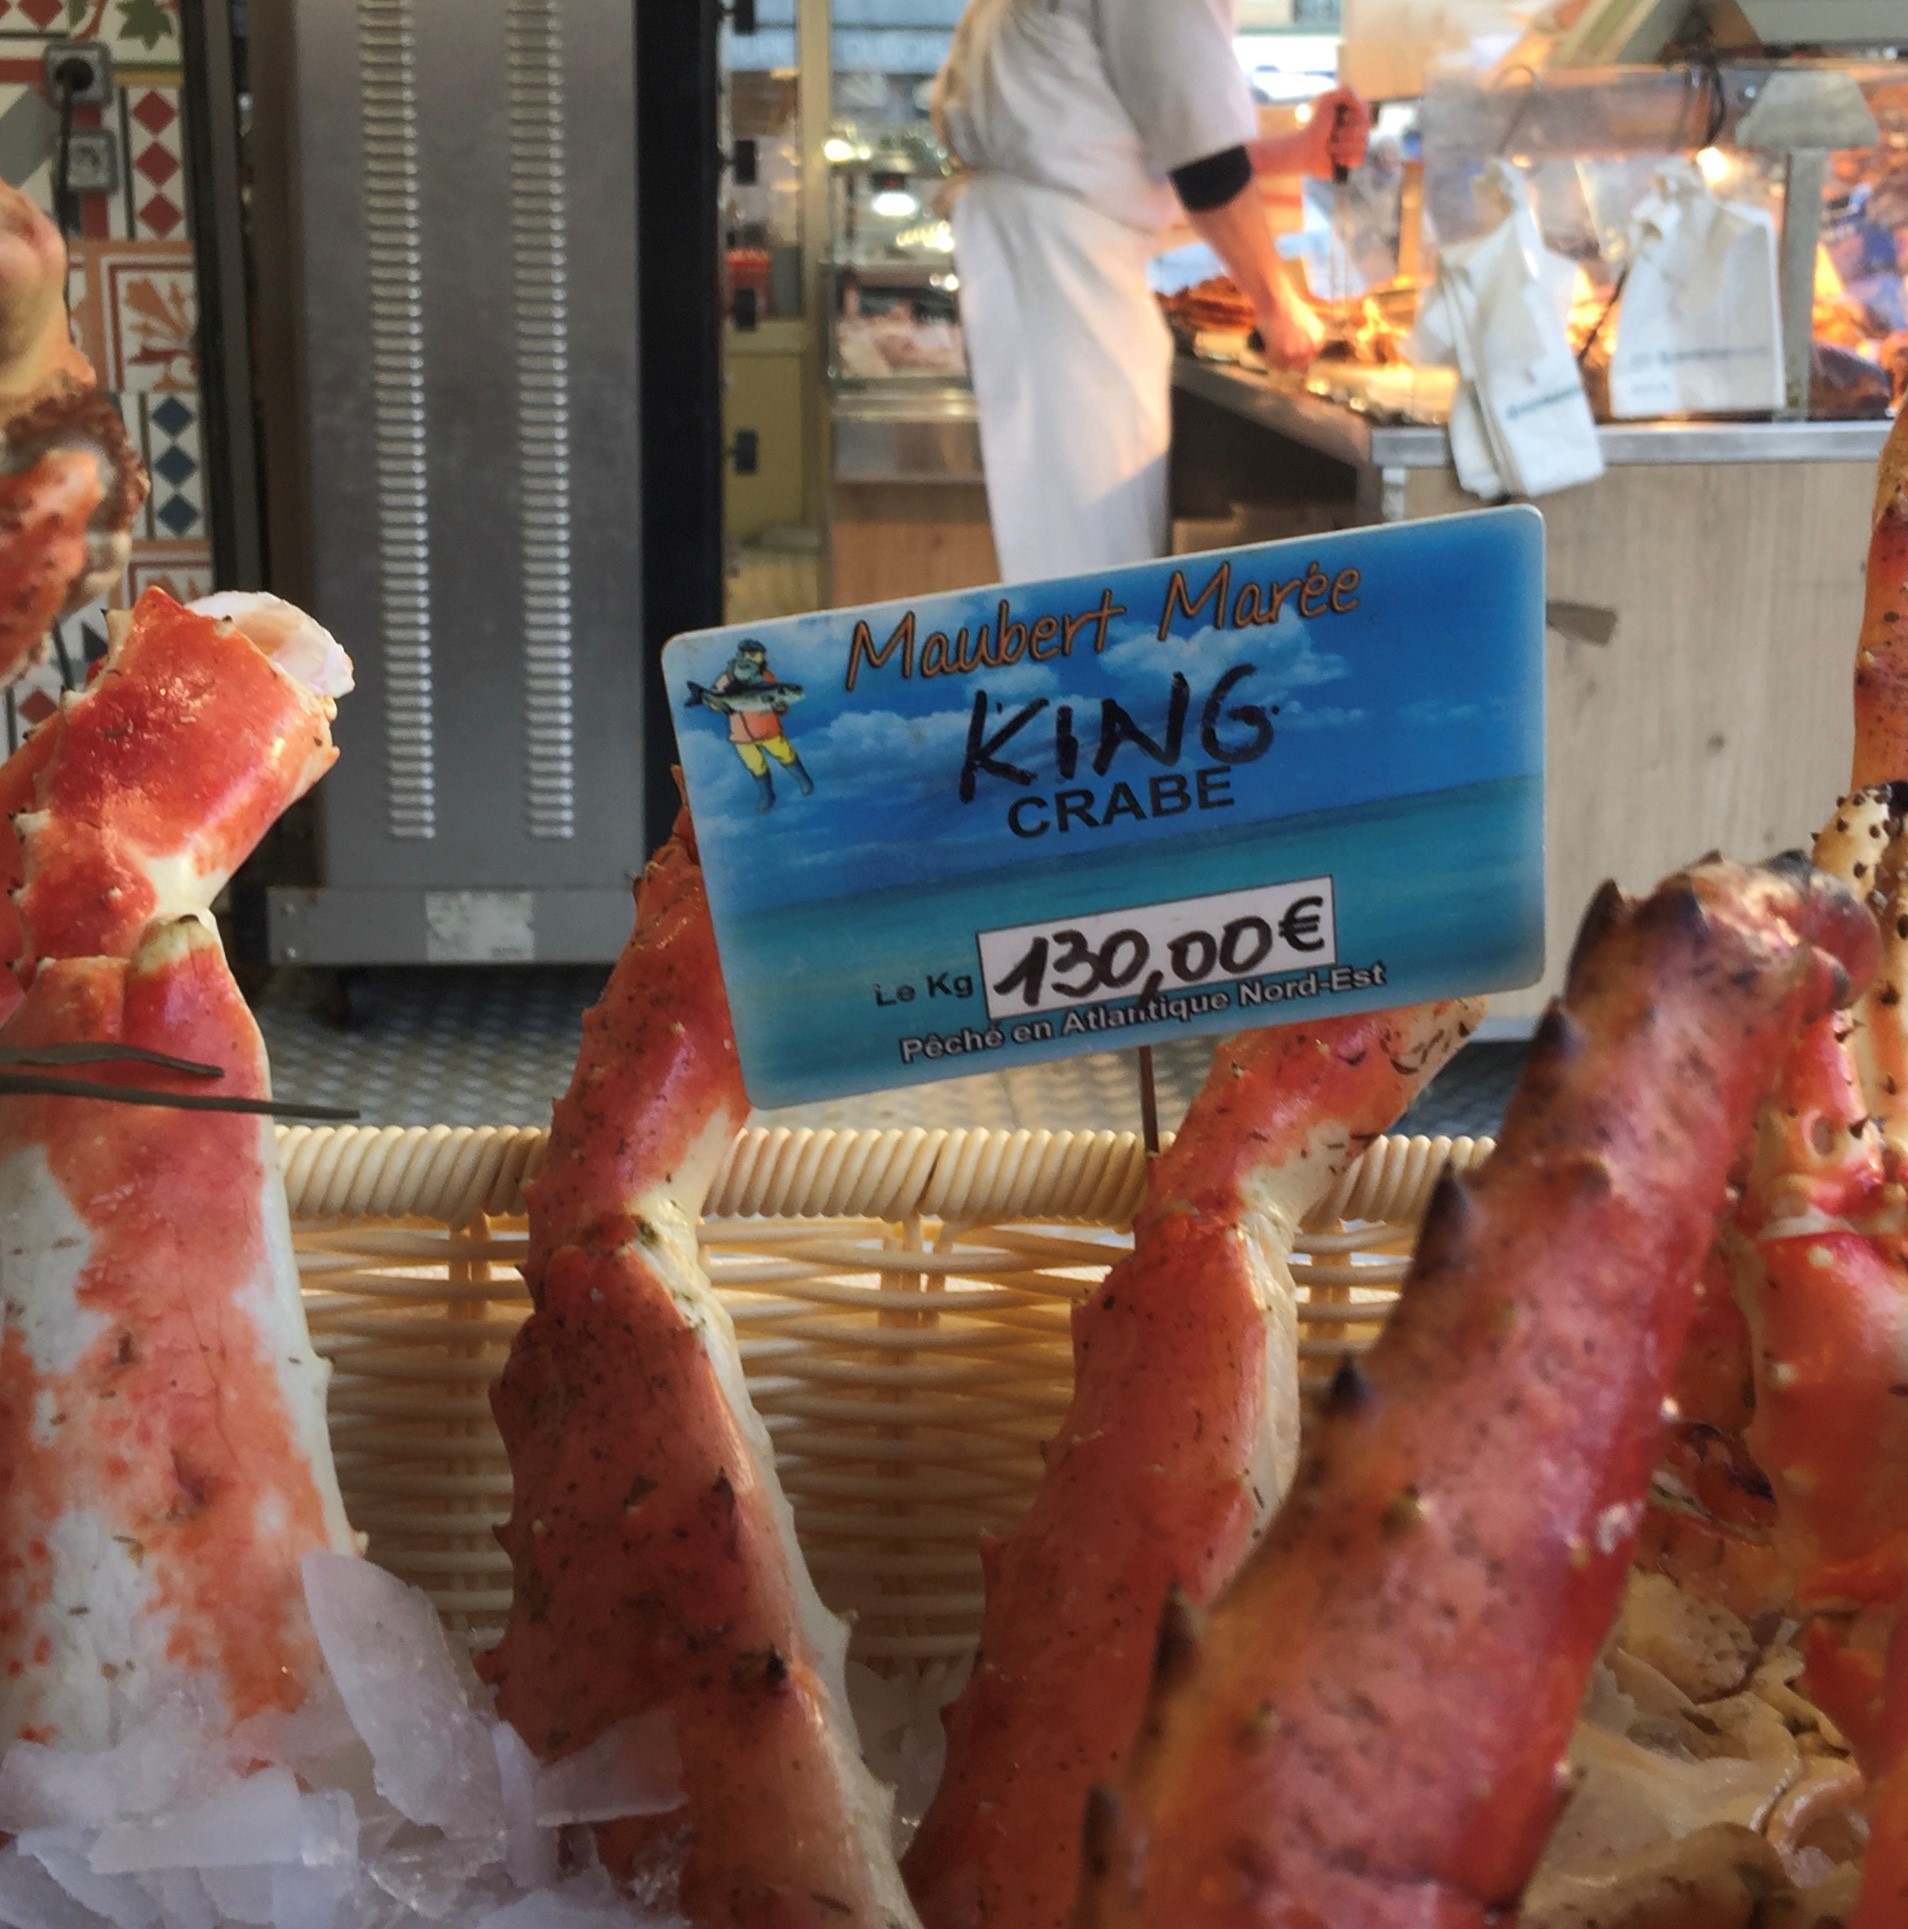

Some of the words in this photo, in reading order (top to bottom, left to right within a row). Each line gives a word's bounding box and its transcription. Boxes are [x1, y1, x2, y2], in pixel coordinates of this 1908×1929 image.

[845, 589, 1127, 692] Maubert
[1157, 560, 1362, 642] Marée
[959, 663, 1275, 804] KING
[1007, 765, 1236, 839] CRABE
[874, 982, 916, 1008] Le
[927, 970, 974, 999] Kg
[992, 895, 1326, 1012] 130,00€
[900, 1018, 1006, 1064] Pêché
[1011, 1015, 1053, 1043] en
[1062, 988, 1230, 1037] Atlantique
[1238, 962, 1388, 1007] Nord-Est
